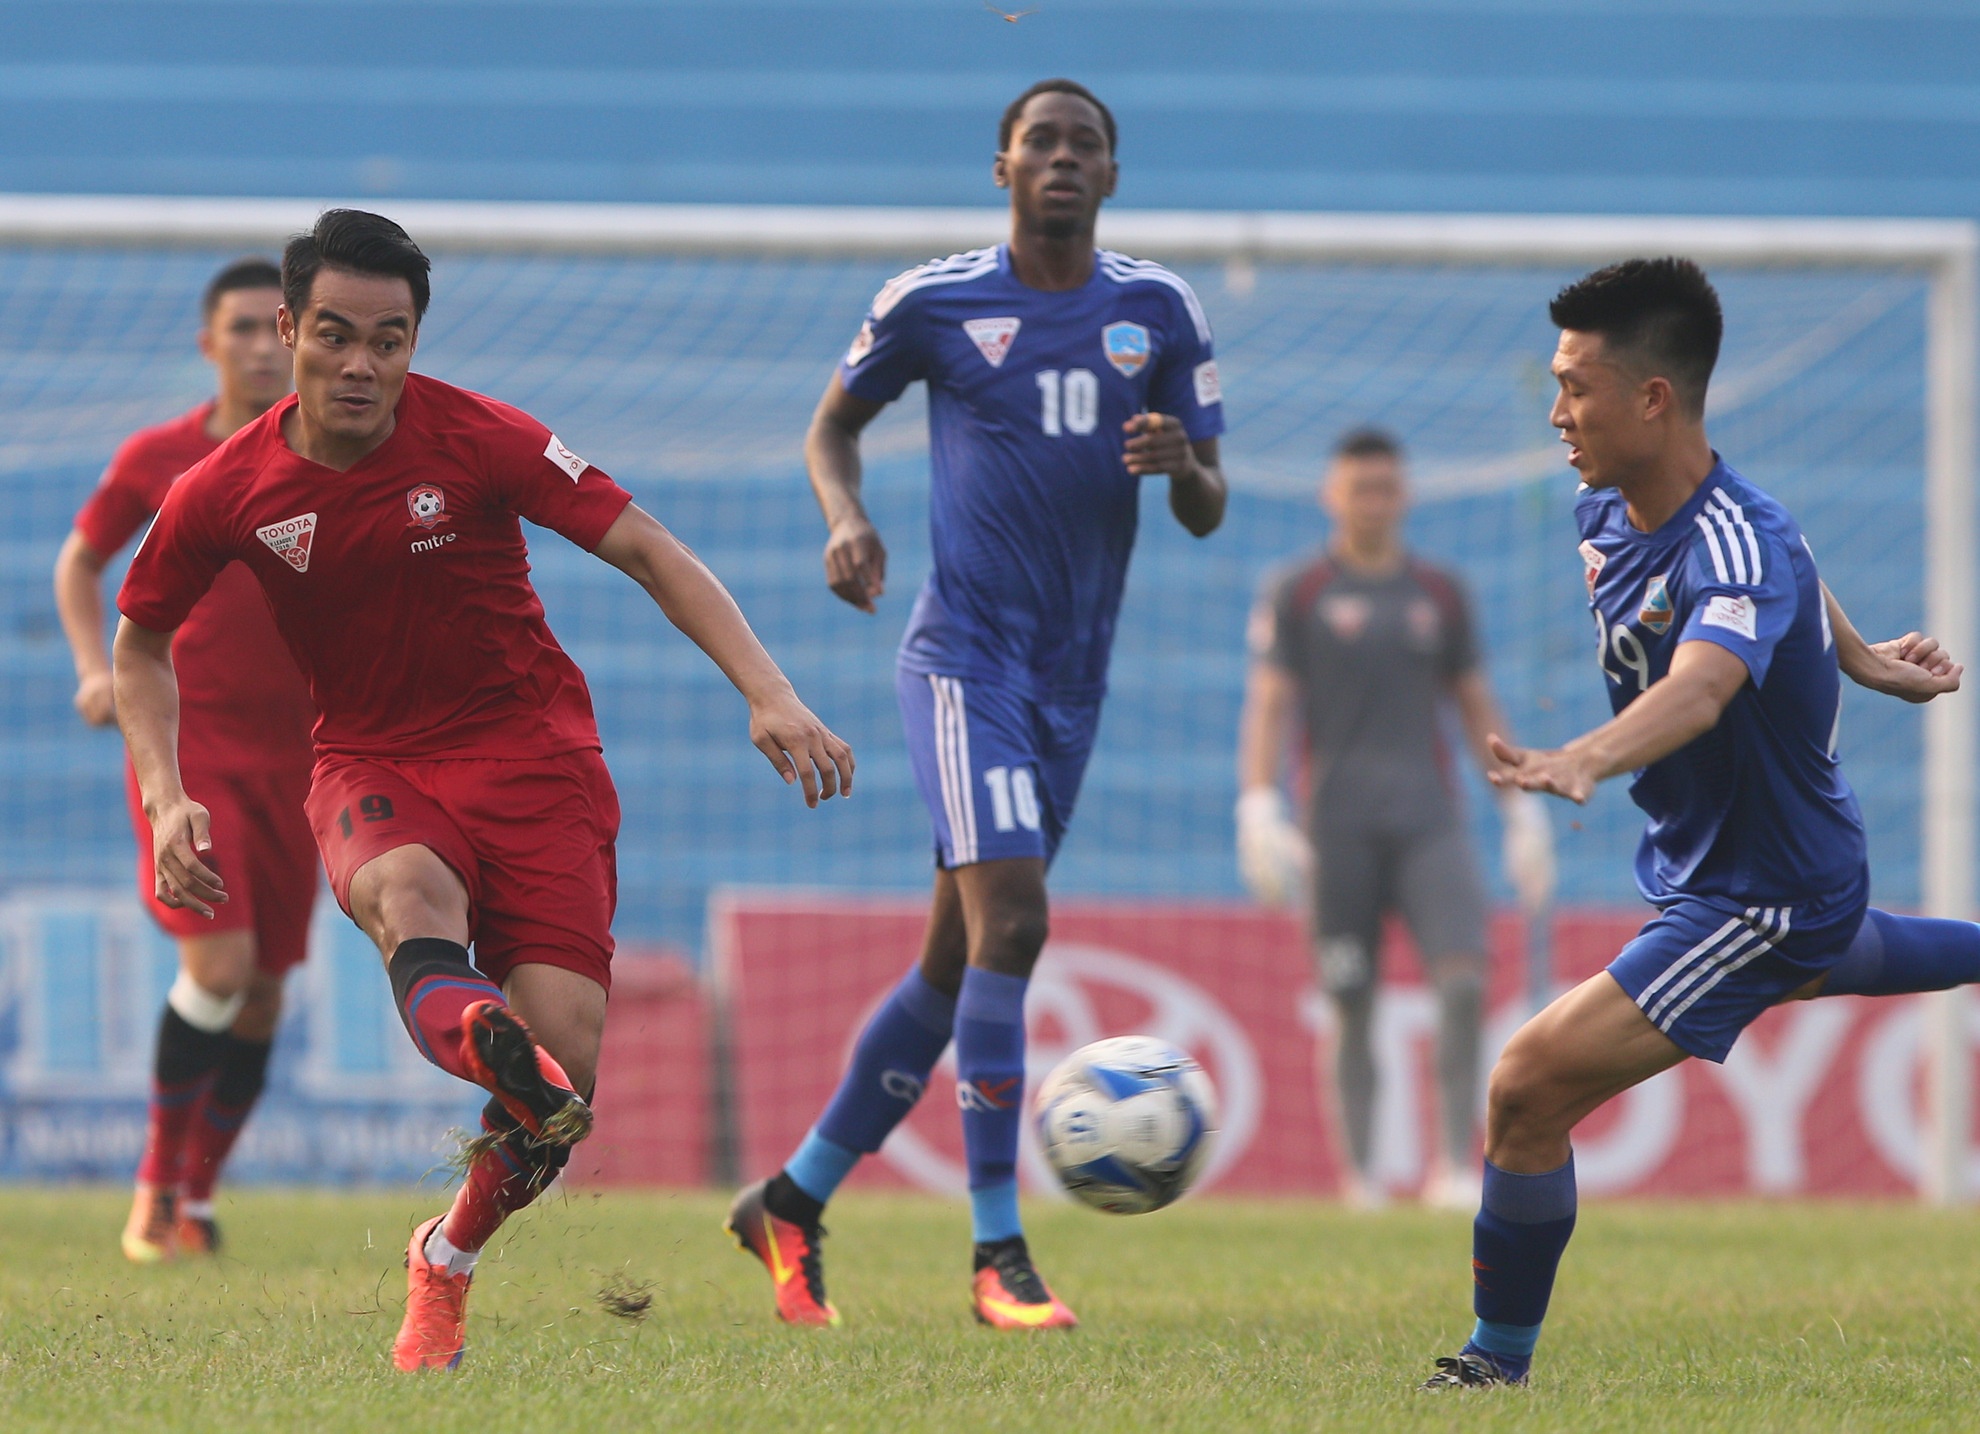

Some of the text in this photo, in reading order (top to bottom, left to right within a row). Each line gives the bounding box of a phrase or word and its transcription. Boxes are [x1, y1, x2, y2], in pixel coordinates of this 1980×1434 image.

[1036, 368, 1098, 437] 10
[261, 518, 313, 540] TOYOTA
[410, 533, 456, 554] mitre
[336, 794, 395, 841] 19
[982, 765, 1040, 833] 10
